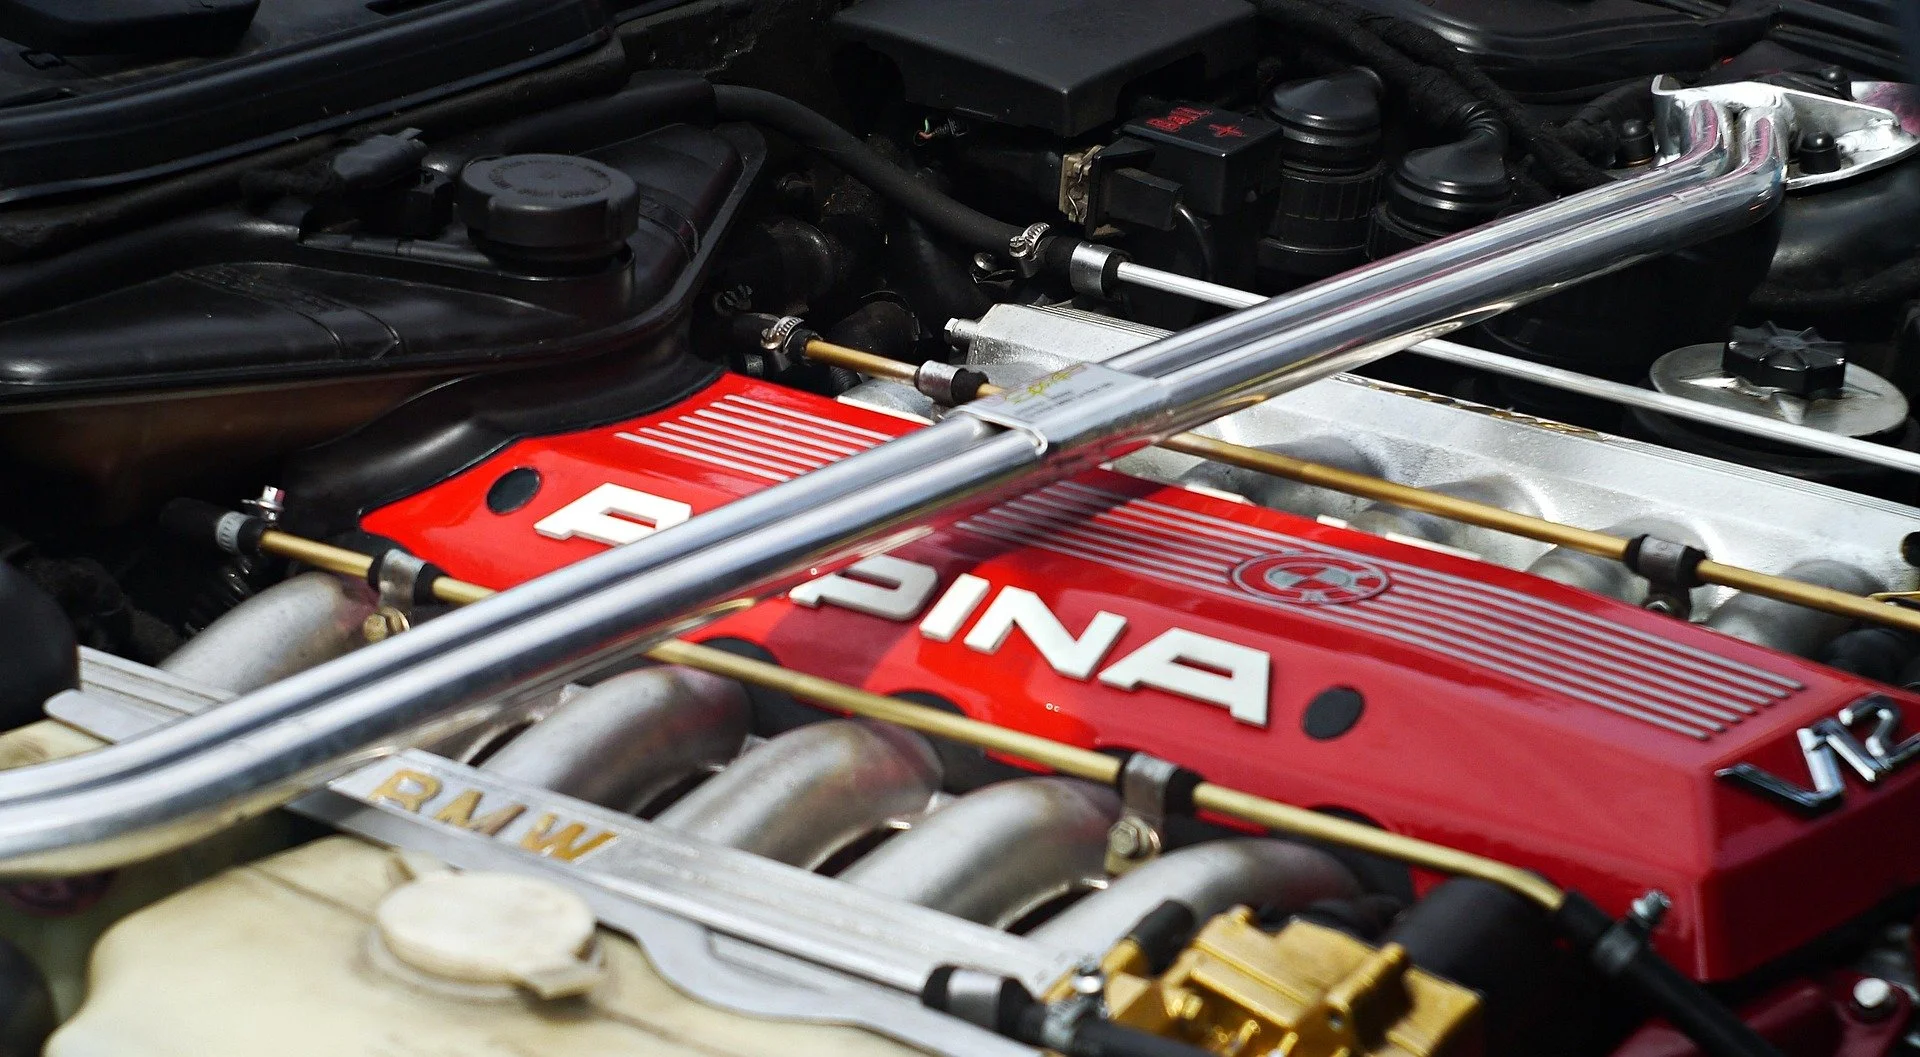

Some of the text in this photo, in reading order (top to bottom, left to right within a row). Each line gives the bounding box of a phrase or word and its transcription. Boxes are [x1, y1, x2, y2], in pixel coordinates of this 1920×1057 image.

[533, 481, 1271, 728] APINA
[1714, 691, 1920, 807] V12
[367, 768, 618, 863] BMW
